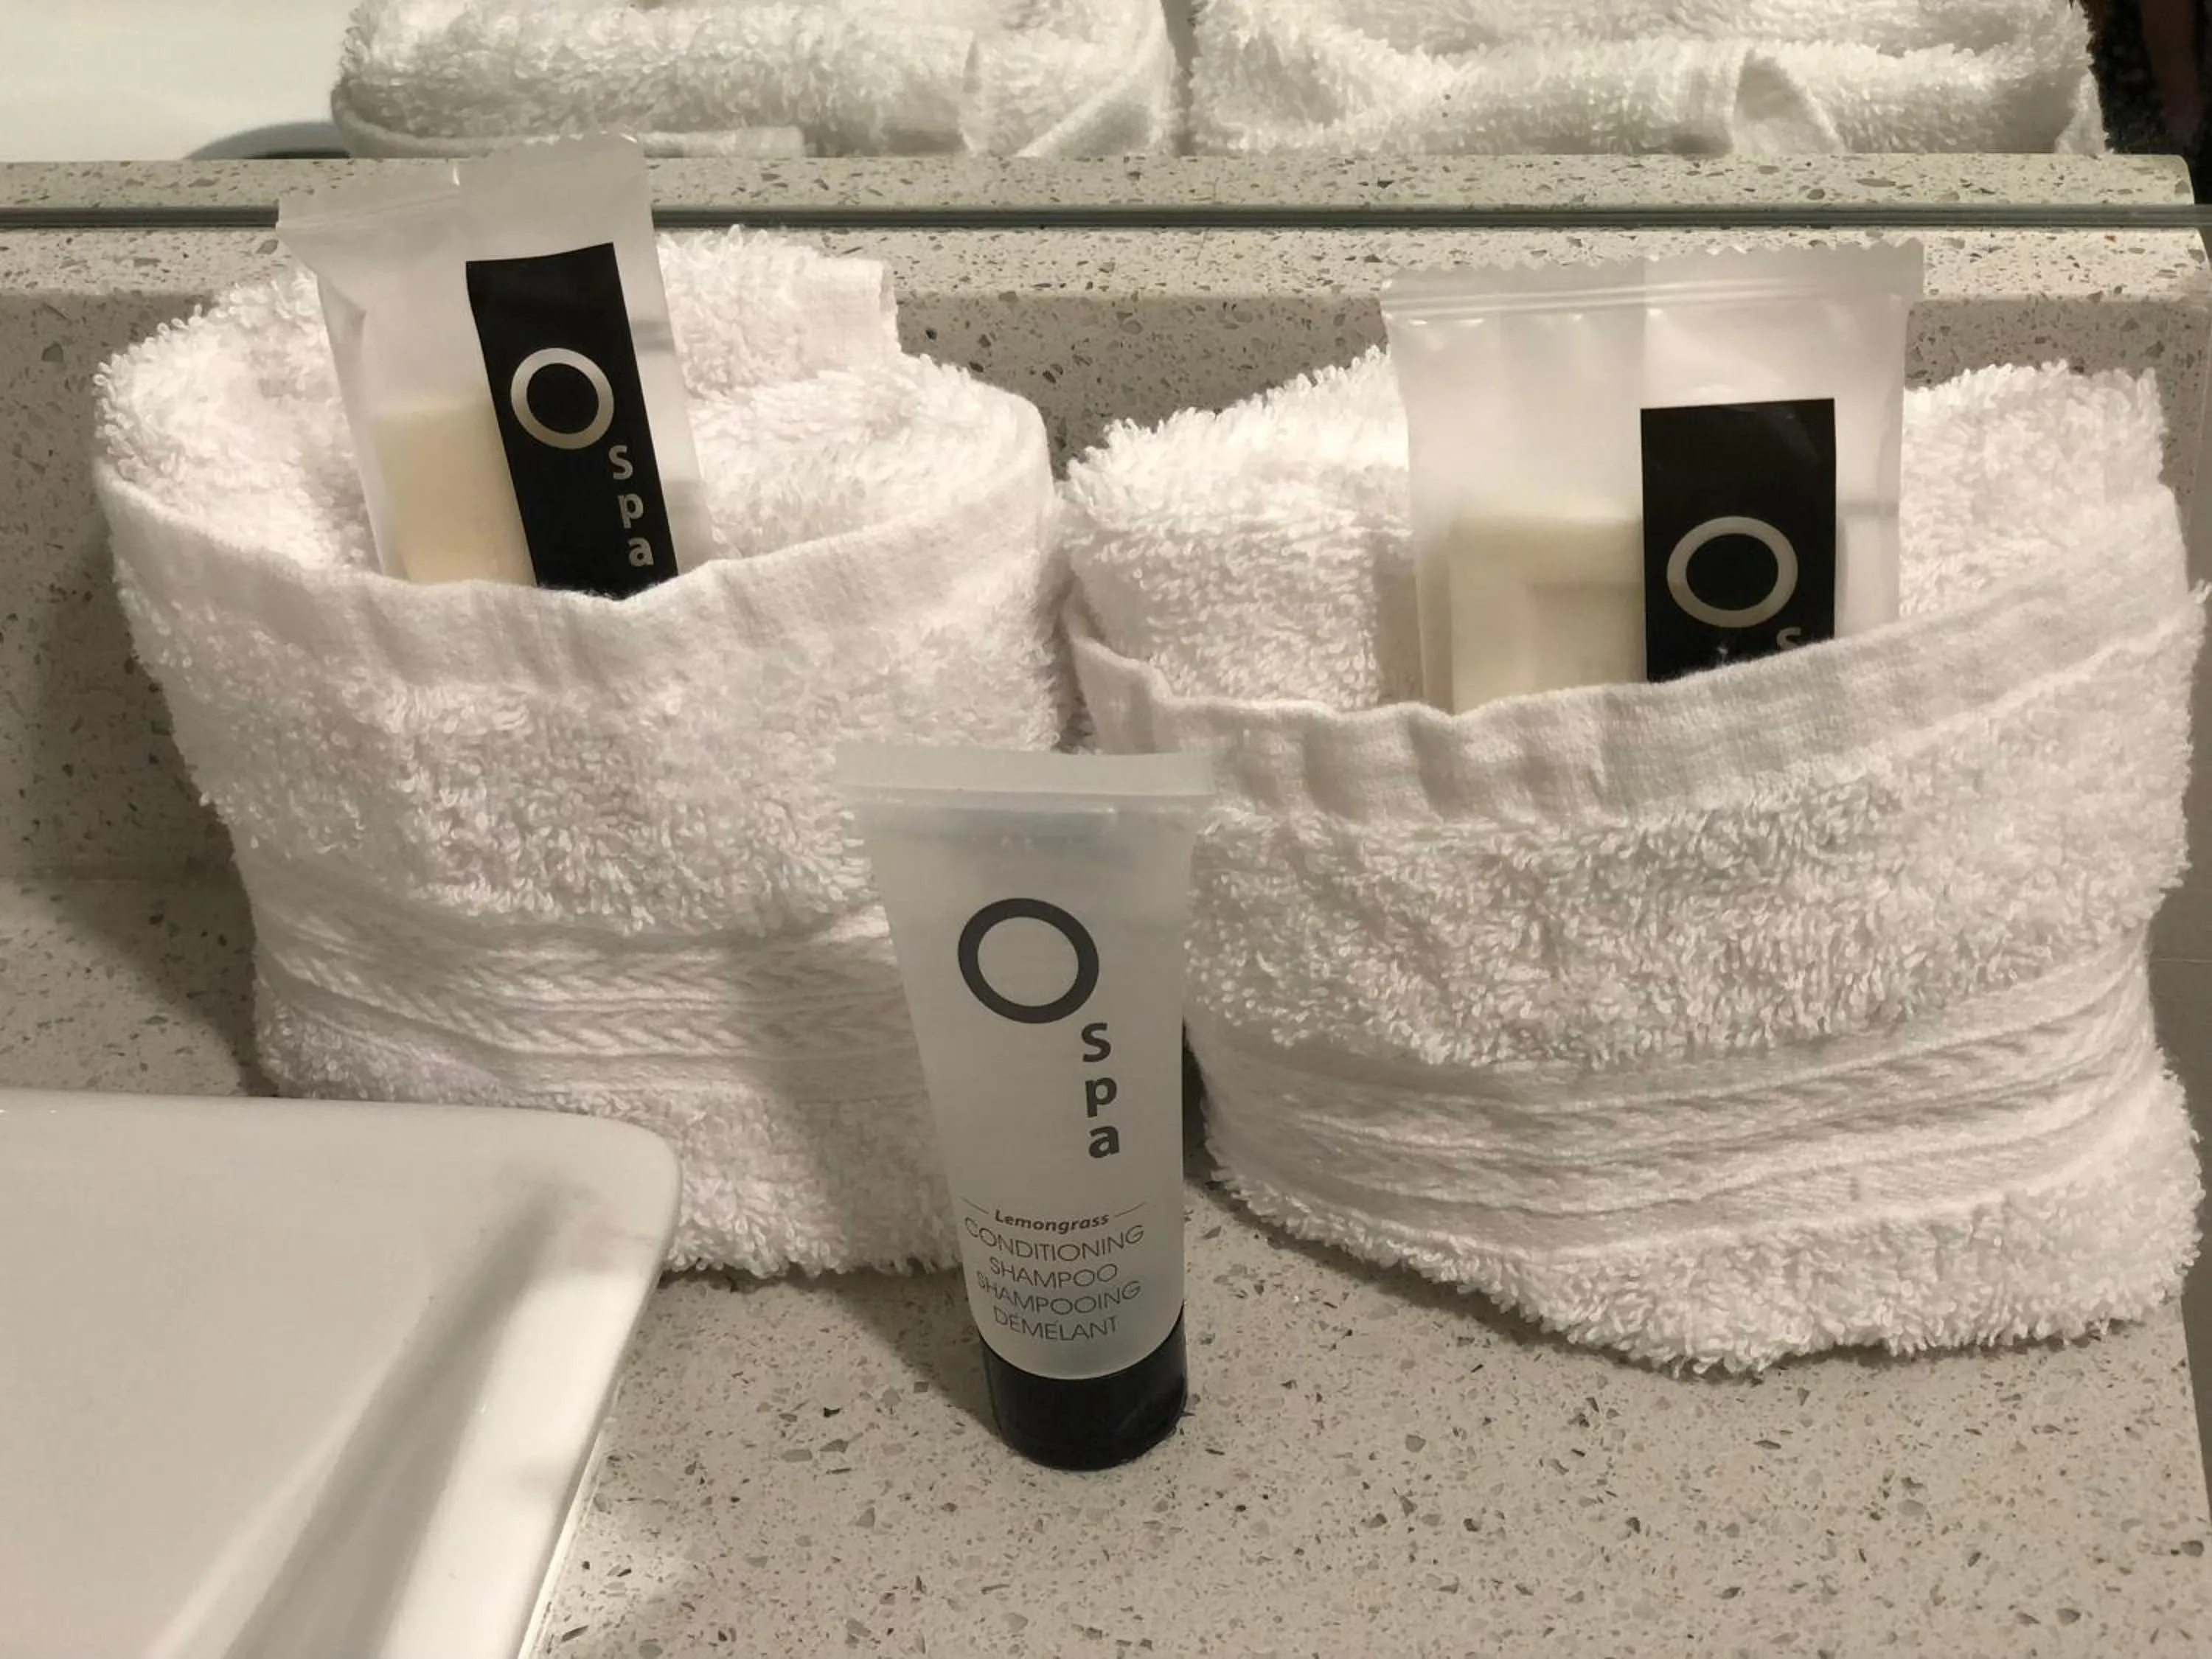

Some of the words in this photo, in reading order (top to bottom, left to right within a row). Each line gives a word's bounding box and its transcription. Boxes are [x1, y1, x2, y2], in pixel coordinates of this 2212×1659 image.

[510, 347, 614, 450] O
[608, 445, 654, 567] spa
[1666, 516, 1798, 628] O
[958, 898, 1099, 1023] O
[1081, 1022, 1120, 1158] spa
[964, 1217, 1144, 1262] CONDITIONING
[989, 1256, 1119, 1289] SHAMPOO
[995, 1209, 1110, 1235] Lemongrass
[976, 1270, 1141, 1315] SHAMPOOING
